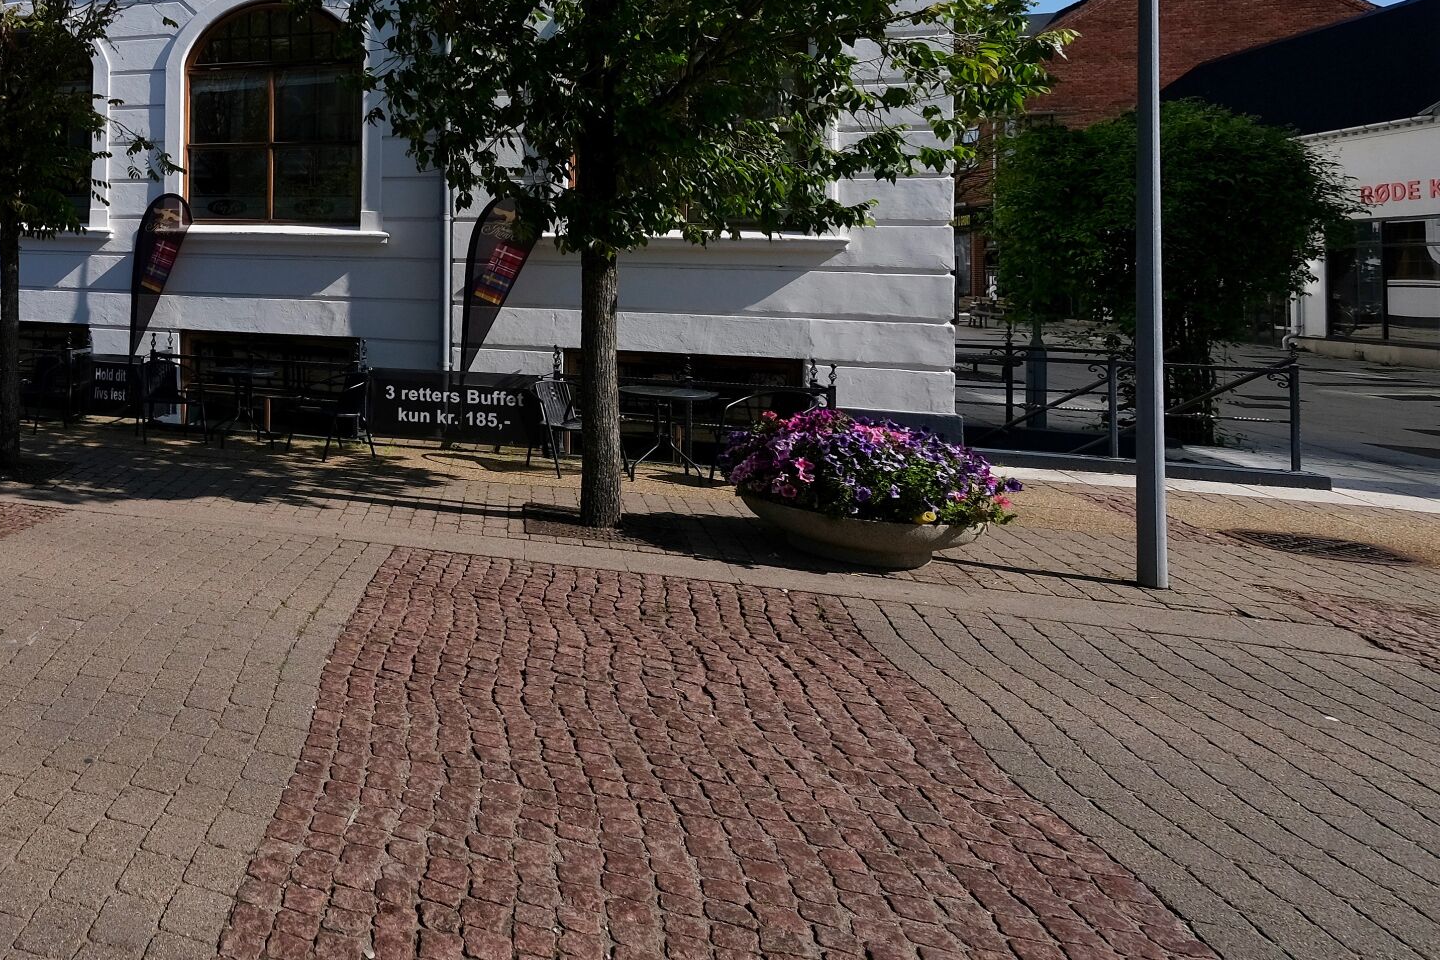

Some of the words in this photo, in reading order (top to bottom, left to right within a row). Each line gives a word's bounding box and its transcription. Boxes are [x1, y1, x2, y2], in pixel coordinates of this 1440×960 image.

[1360, 180, 1421, 205] RØDE
[95, 368, 113, 381] Hold
[115, 368, 126, 382] dit
[385, 385, 396, 400] 3
[401, 388, 460, 404] retters
[466, 389, 525, 407] Buffet
[397, 407, 430, 423] kun
[436, 409, 459, 425] kr.
[465, 411, 511, 431] 185,-
